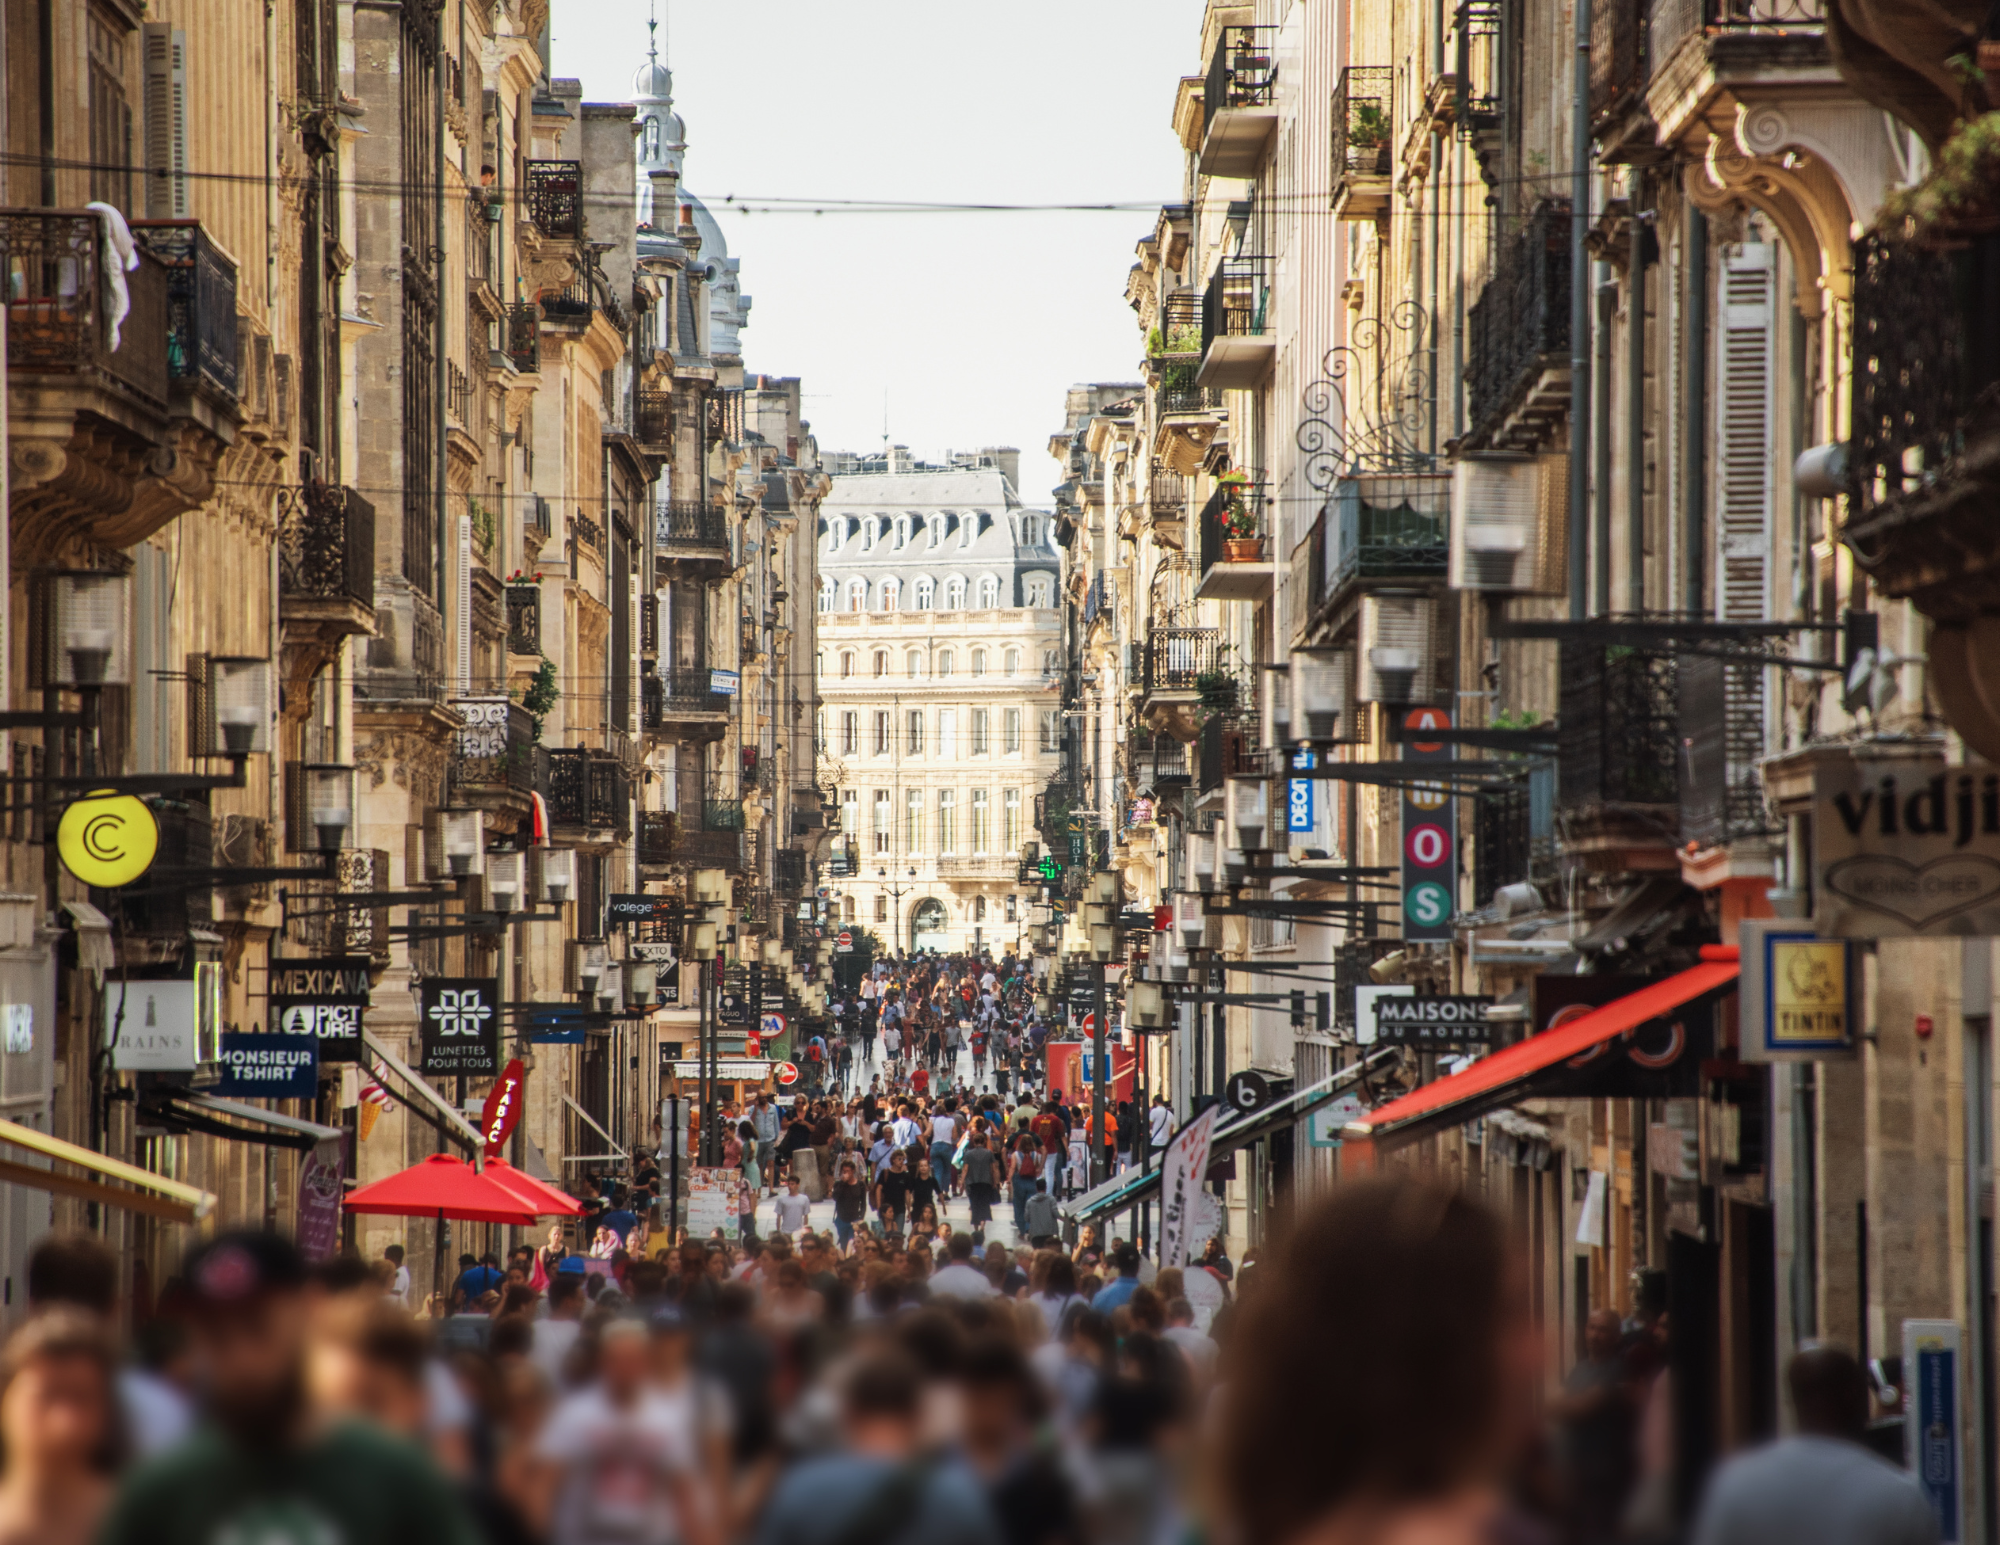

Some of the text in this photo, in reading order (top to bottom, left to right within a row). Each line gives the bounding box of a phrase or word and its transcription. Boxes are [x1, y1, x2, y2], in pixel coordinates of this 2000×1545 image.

[612, 903, 653, 915] valege
[271, 969, 370, 996] MEXICANA
[315, 1005, 361, 1022] PICT
[1379, 1001, 1490, 1021] MAISONS
[315, 1020, 358, 1039] URE
[1379, 1027, 1491, 1038] DU MONDE
[121, 1035, 182, 1049] RAINS
[220, 1050, 313, 1066] MONSIEUR
[432, 1045, 486, 1057] LUNETTES
[427, 1057, 492, 1069] POUR TOUS
[231, 1065, 297, 1081] TSHIRT
[488, 1077, 518, 1144] TABAC
